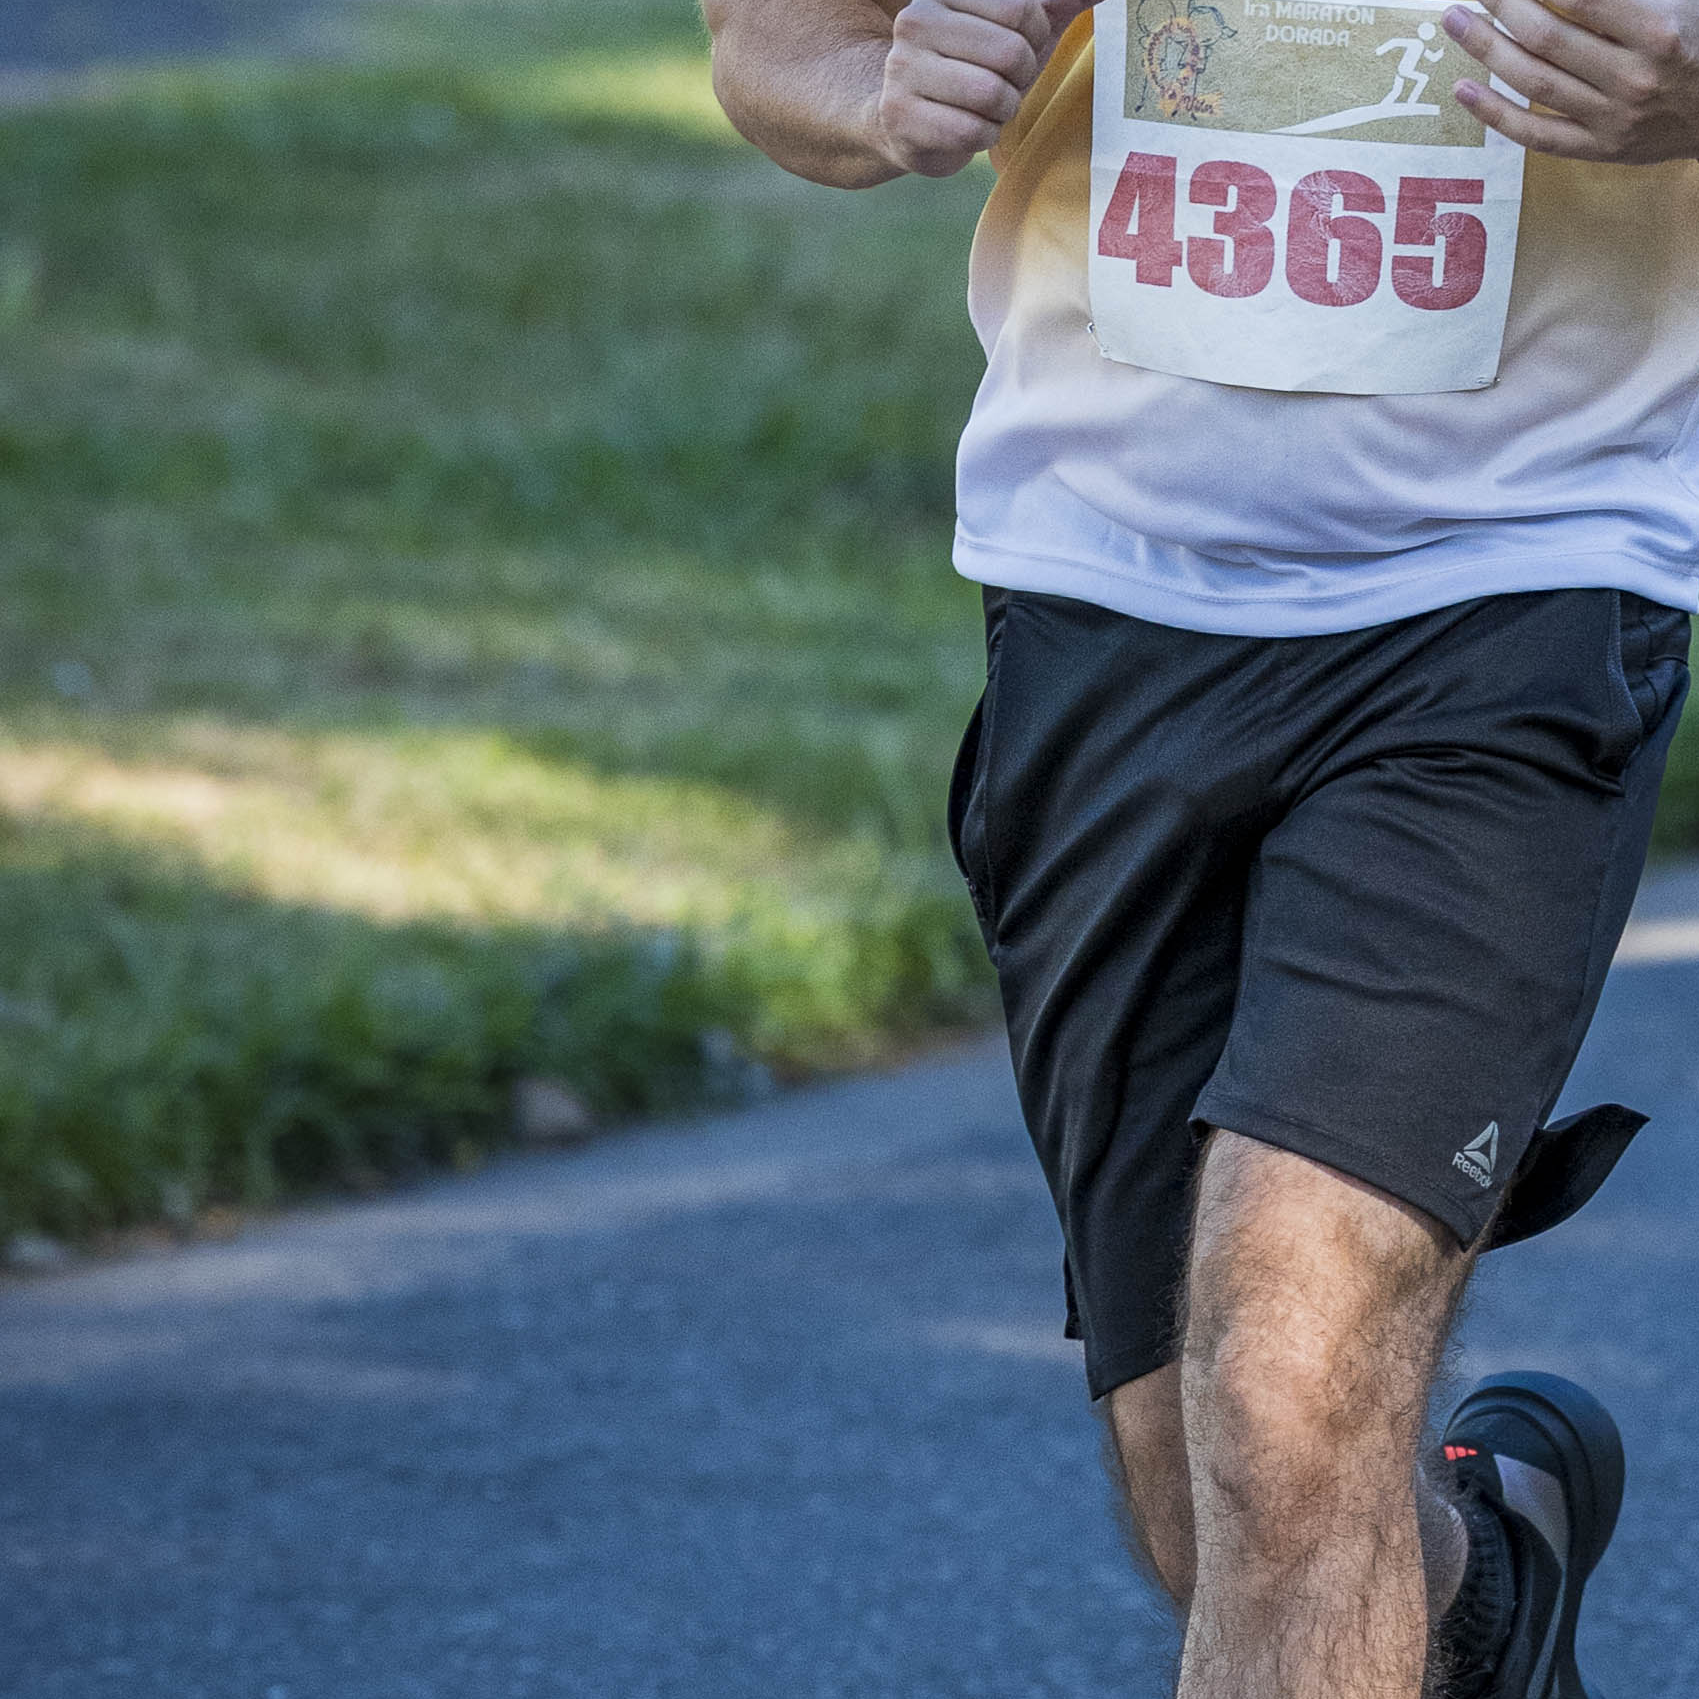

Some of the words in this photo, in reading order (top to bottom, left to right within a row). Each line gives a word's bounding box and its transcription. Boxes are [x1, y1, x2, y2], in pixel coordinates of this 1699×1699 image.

[1265, 23, 1351, 47] DORADA
[1097, 151, 1488, 311] 4365
[1451, 1151, 1493, 1189] Reebok
